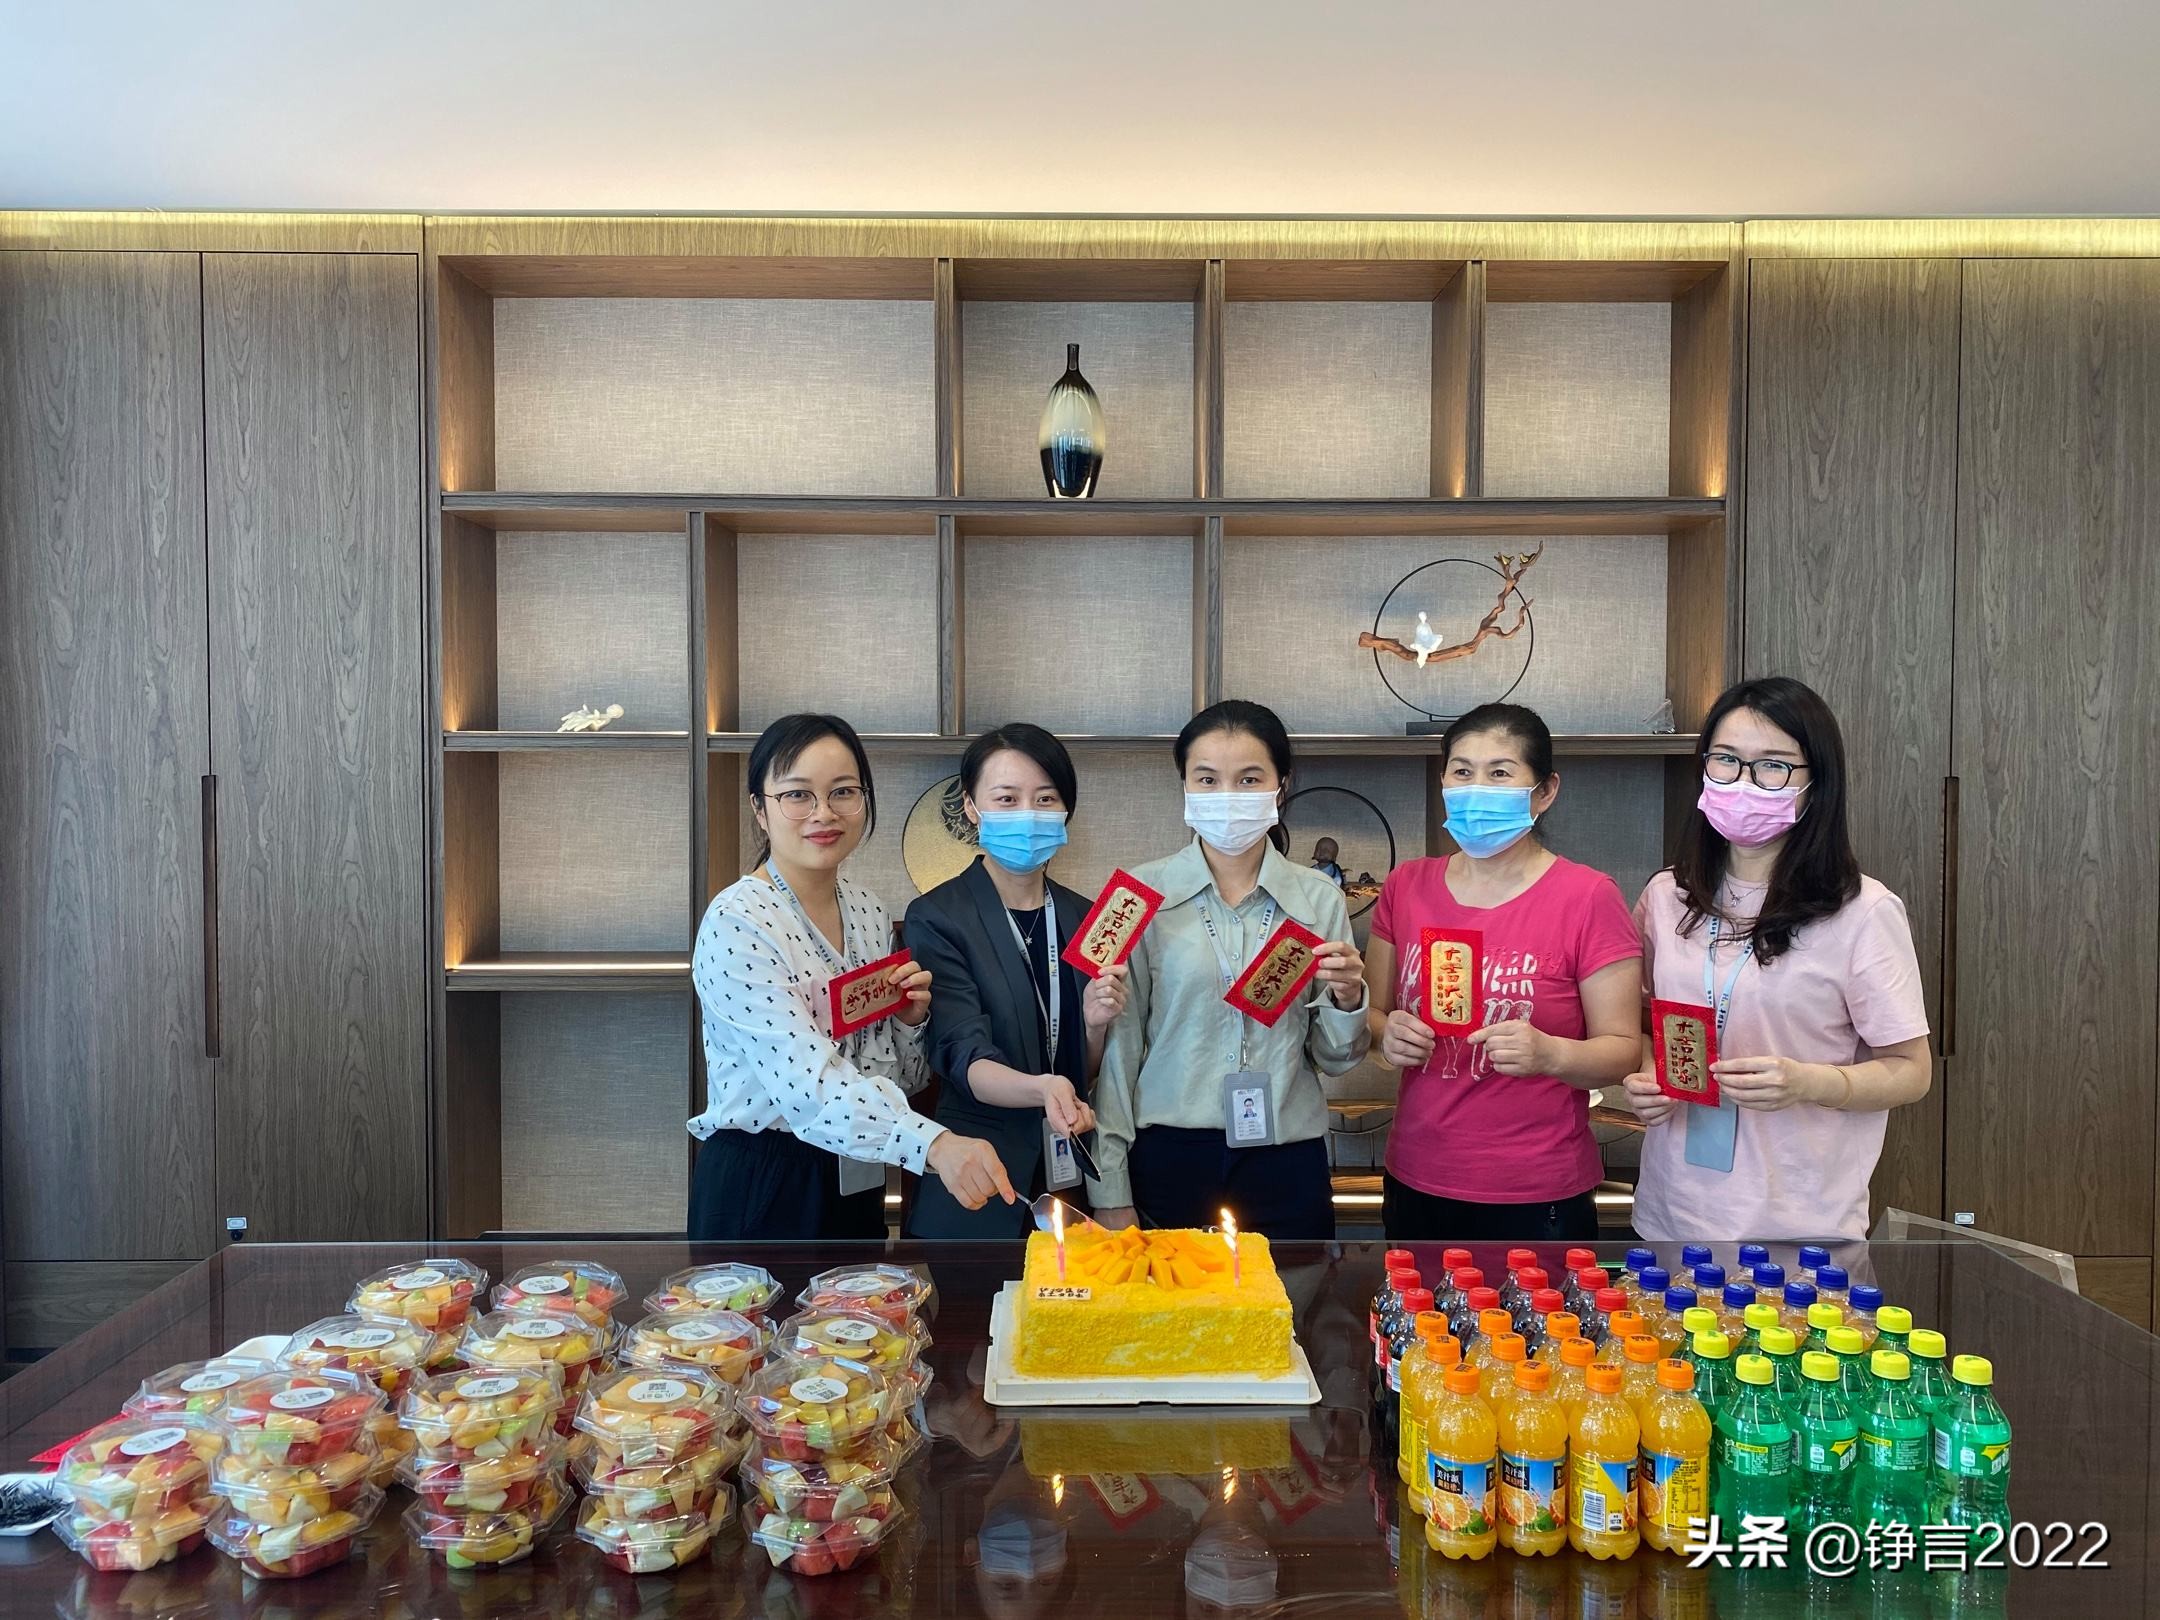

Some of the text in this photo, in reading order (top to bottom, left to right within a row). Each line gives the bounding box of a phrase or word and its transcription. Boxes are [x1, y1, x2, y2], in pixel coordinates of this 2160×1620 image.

[1091, 897, 1138, 963] 大吉大利
[1252, 946, 1305, 1007] 大吉大利
[1440, 946, 1464, 1022] 大吉大利
[1673, 1020, 1701, 1091] 大吉大利
